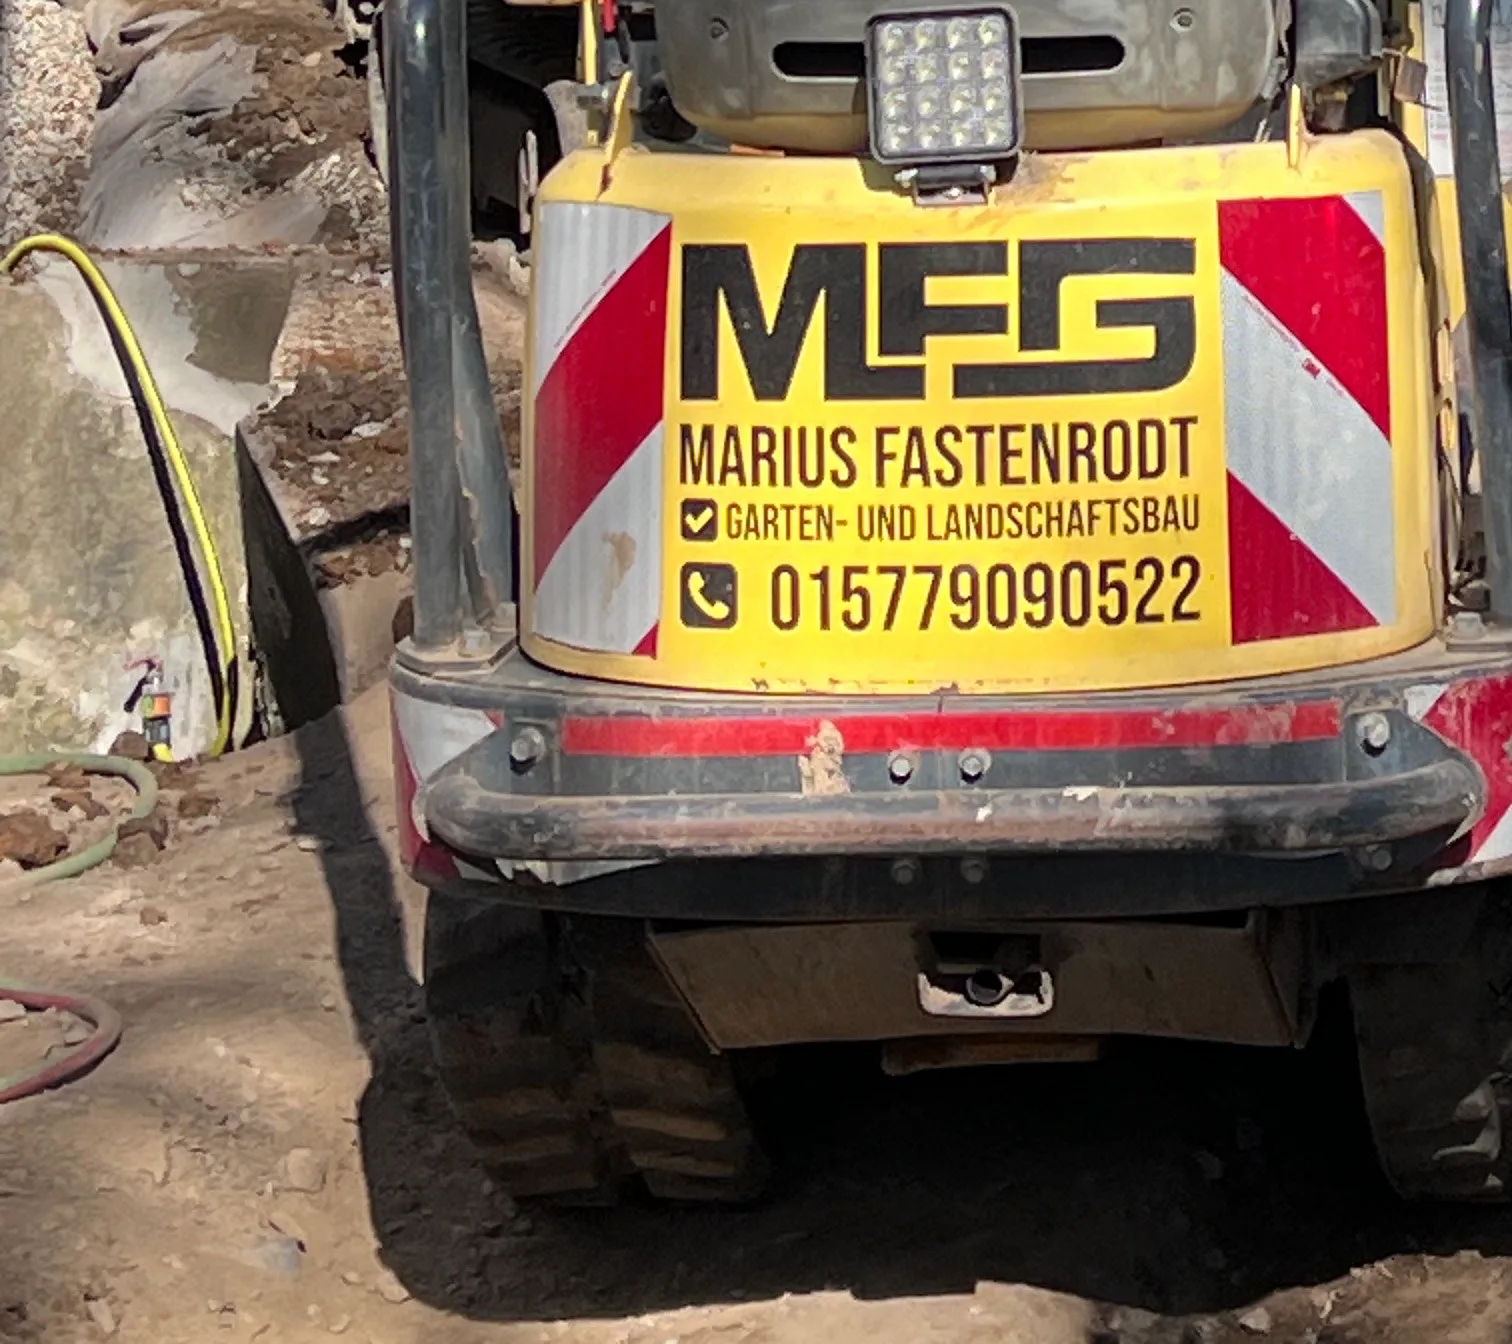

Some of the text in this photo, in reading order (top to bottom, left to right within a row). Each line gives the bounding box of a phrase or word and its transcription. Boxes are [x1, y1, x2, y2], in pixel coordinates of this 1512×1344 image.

[679, 237, 1196, 402] MFG
[679, 415, 1198, 488] MARIUS FASTENRODT
[726, 494, 1199, 541] GARTEN- UND LANDSCHAFTSBAU
[771, 555, 1201, 631] 015779090522
